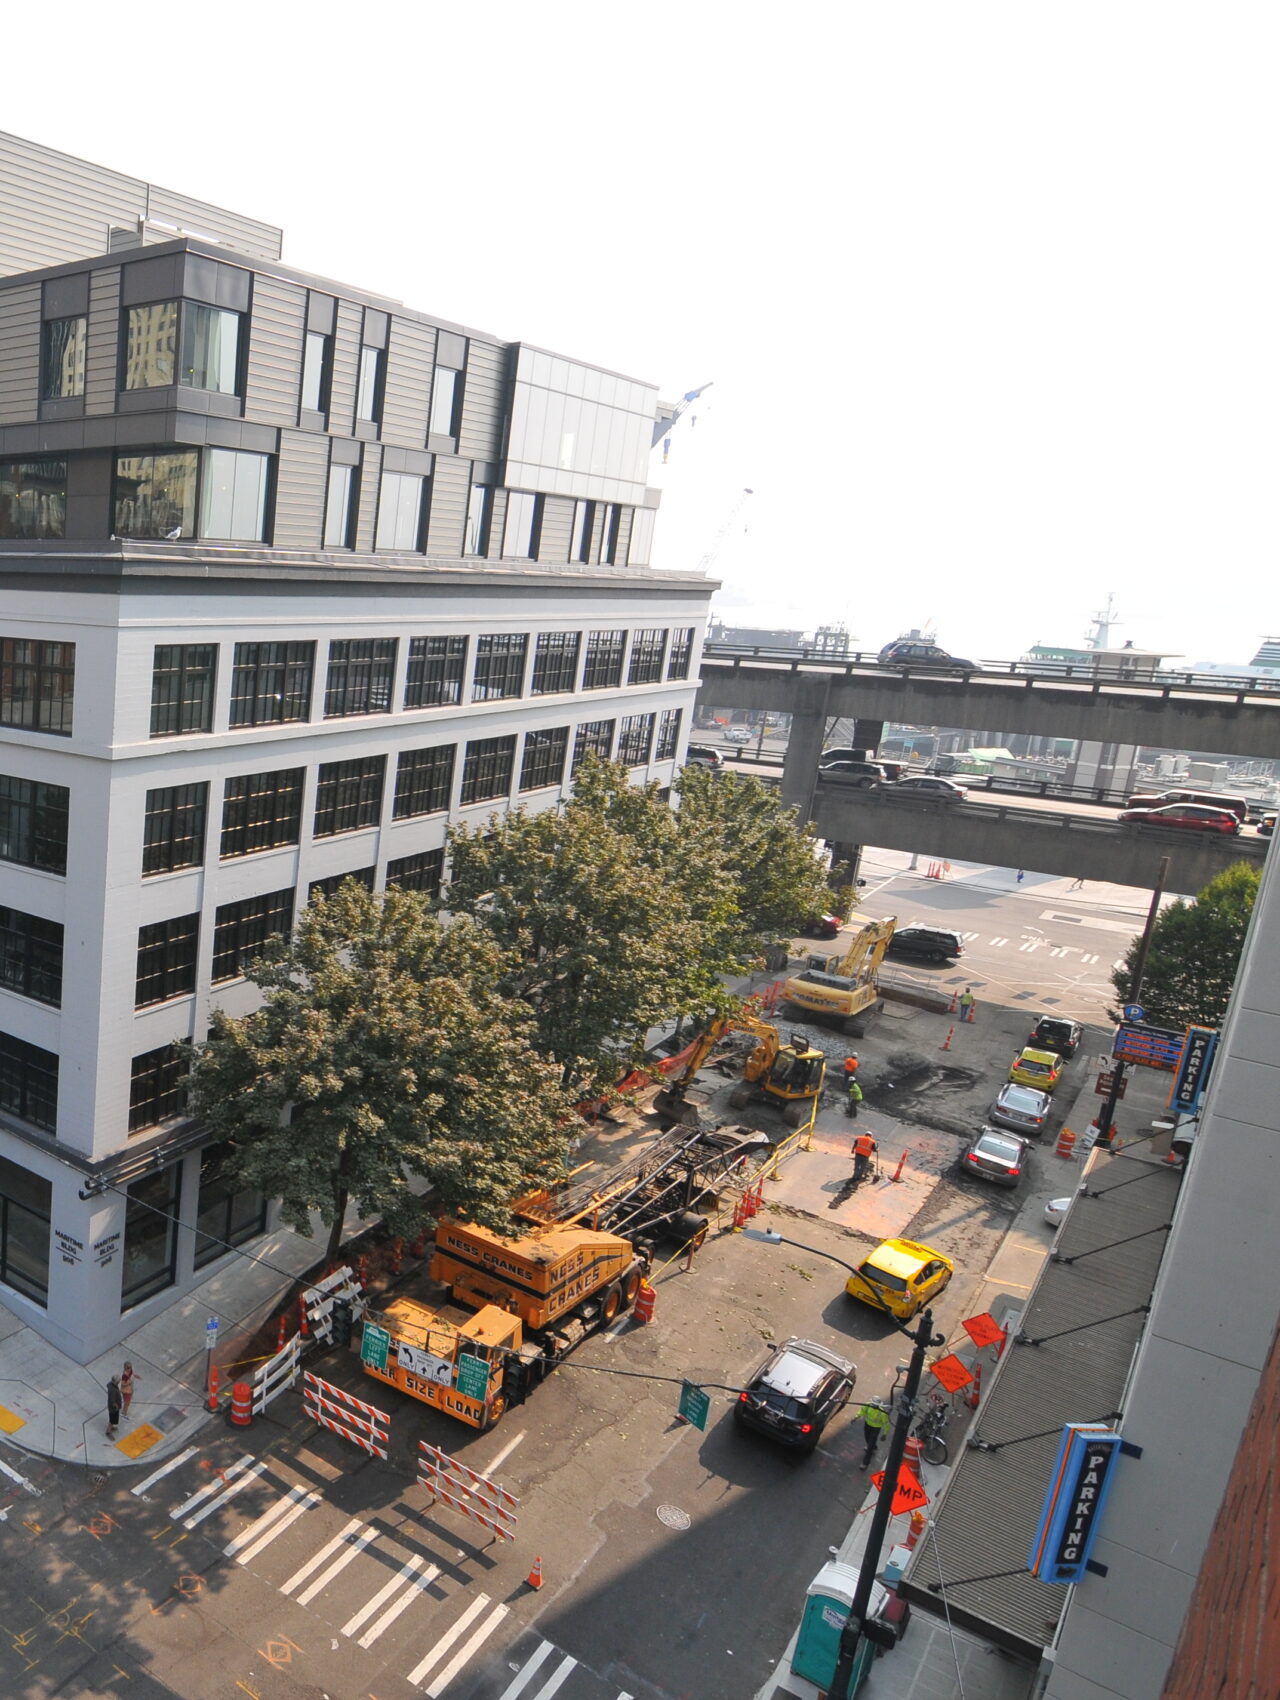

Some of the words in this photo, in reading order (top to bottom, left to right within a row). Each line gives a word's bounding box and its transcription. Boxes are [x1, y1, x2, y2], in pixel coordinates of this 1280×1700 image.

[1181, 1040, 1206, 1100] PARKING
[55, 1229, 84, 1250] MARITIME
[61, 1241, 77, 1255] BLDG
[93, 1232, 120, 1250] MARITIME
[100, 1243, 115, 1256] BLDG
[447, 1236, 479, 1257] NESS
[481, 1251, 533, 1282] CRANES
[549, 1250, 584, 1285] NESS
[548, 1266, 600, 1314] CRANES
[365, 1334, 387, 1349] FERRIES
[399, 1360, 414, 1370] ONLY
[433, 1374, 450, 1385] ONLY
[406, 1377, 436, 1399] SIZE
[446, 1396, 480, 1420] LOAD
[878, 1475, 923, 1502] BMP
[1064, 1456, 1104, 1560] PARKING
